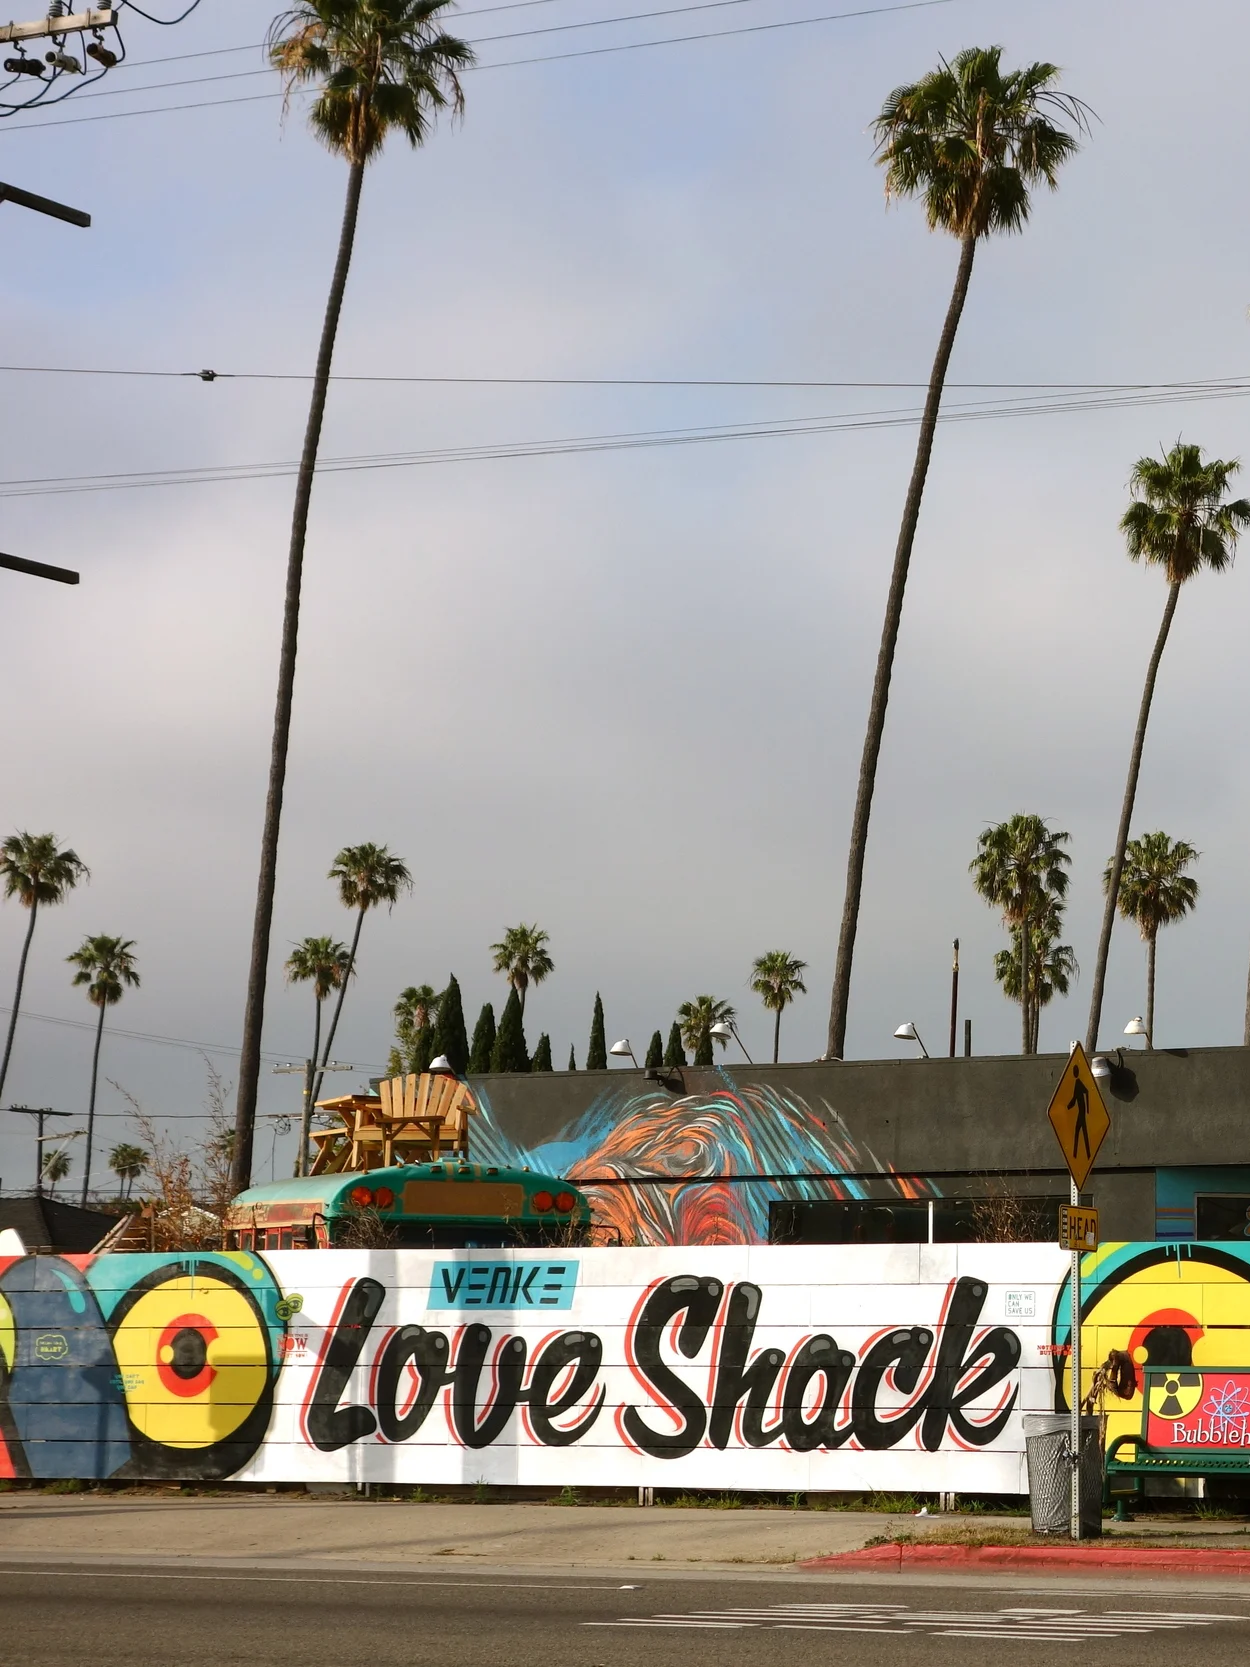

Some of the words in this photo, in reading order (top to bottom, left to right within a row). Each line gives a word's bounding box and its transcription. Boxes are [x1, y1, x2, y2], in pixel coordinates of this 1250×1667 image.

[277, 1337, 308, 1350] NOW
[301, 1277, 607, 1452] Love
[616, 1274, 1022, 1459] Shack
